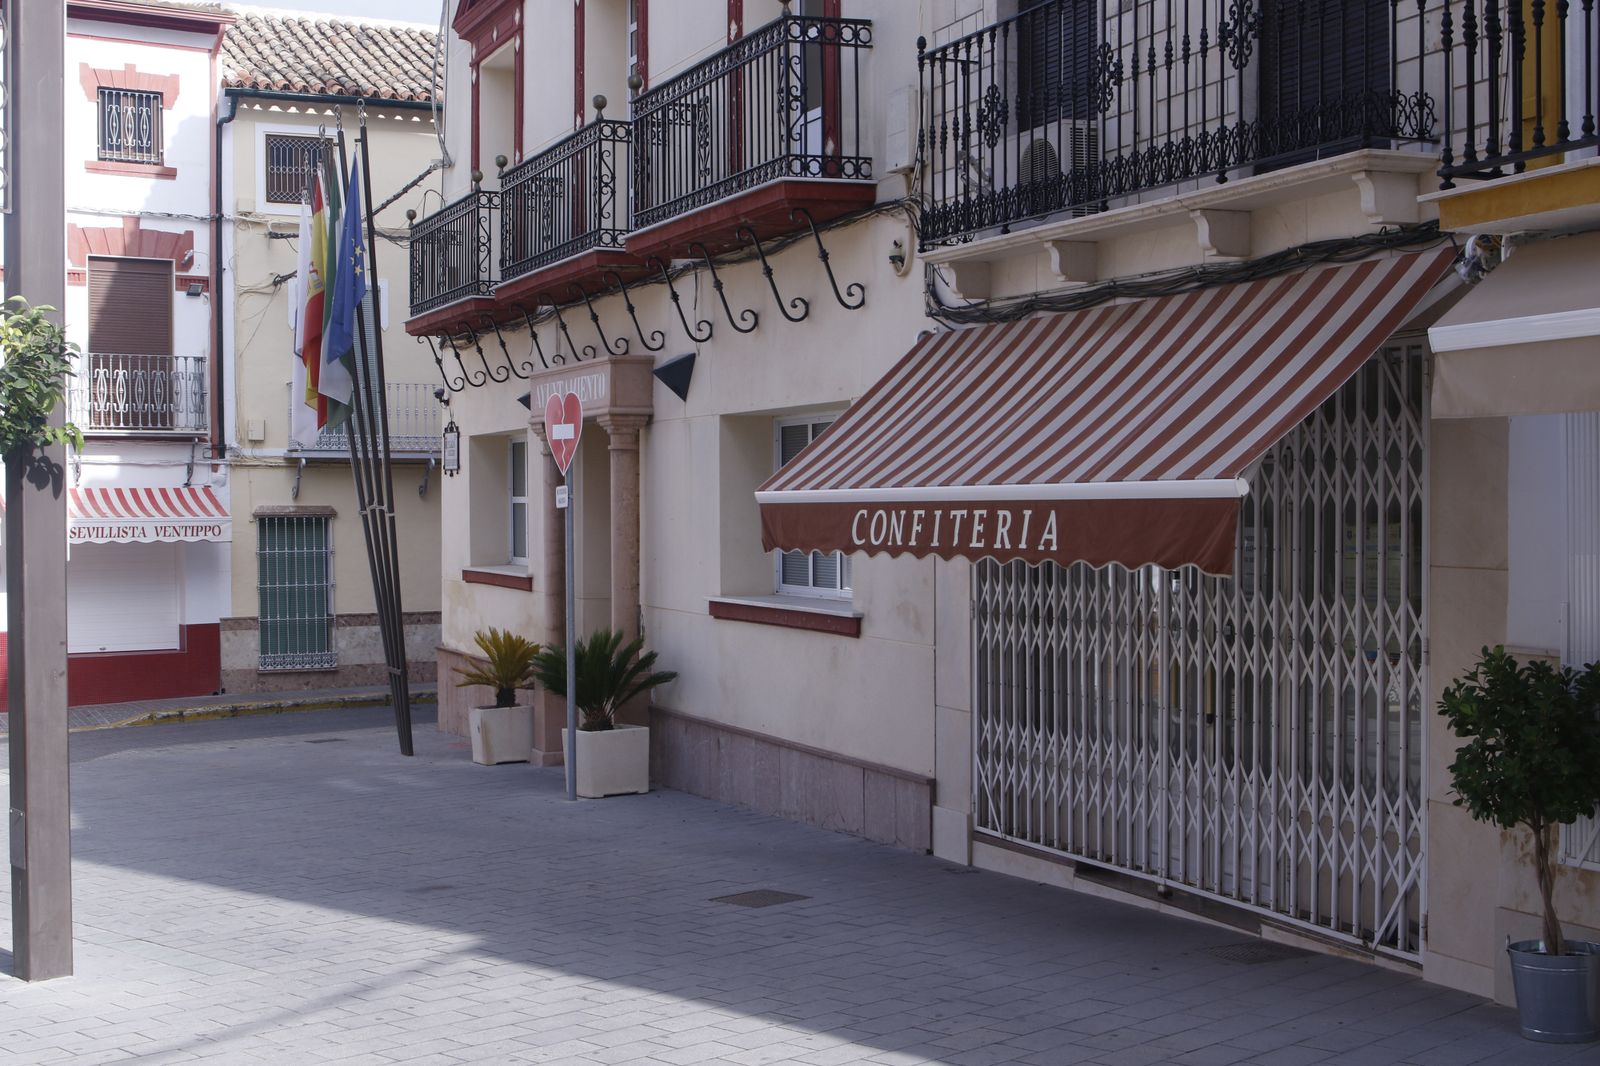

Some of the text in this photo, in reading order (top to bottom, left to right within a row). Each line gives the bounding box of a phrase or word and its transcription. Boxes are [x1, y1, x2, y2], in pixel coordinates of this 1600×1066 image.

[69, 524, 222, 539] SEVILLISTA VENTIPPO
[851, 508, 1059, 553] CONFITERIA
